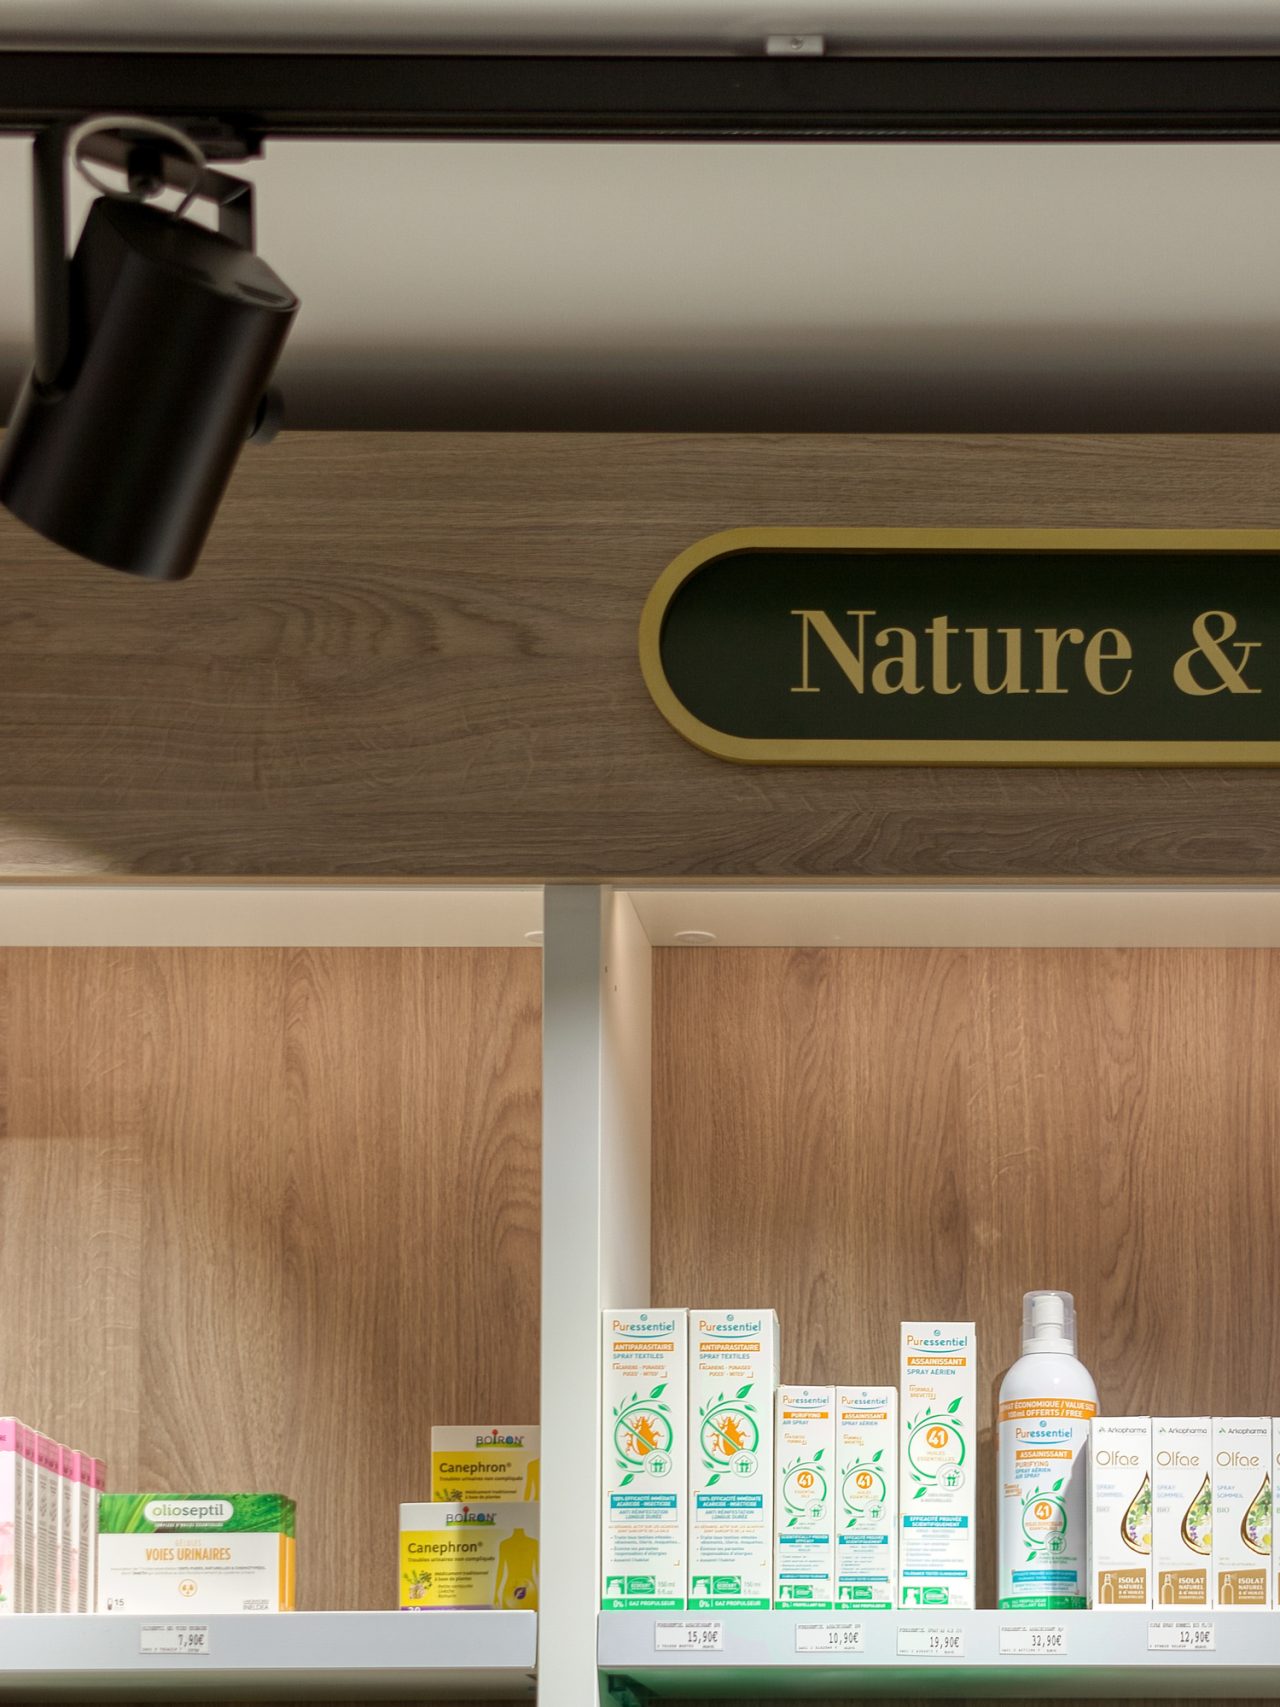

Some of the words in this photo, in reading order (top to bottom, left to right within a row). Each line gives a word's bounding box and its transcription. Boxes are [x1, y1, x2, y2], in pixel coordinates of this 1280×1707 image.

[790, 609, 1133, 697] Nature
[1172, 609, 1262, 697] &
[613, 1320, 675, 1332] Puressentiel
[699, 1320, 761, 1332] Puressentiel
[907, 1335, 967, 1346] Puressentiel
[783, 1395, 829, 1404] Puressentiel
[842, 1396, 888, 1405] Puressentiel
[929, 1430, 946, 1444] 41
[1016, 1428, 1072, 1438] Puressentiel
[1096, 1451, 1139, 1466] Olfae
[1157, 1451, 1199, 1466] Olfae
[1217, 1451, 1259, 1466] Olfae
[799, 1475, 812, 1485] 41
[858, 1475, 871, 1486] 41
[153, 1503, 223, 1519] olioseptil
[1036, 1505, 1050, 1518] 41
[146, 1548, 174, 1561] VOIES
[177, 1548, 231, 1561] URINAIRES
[178, 1634, 205, 1648] 7,90€
[688, 1631, 718, 1643] 15,90€
[829, 1633, 859, 1645] 10,90€
[930, 1636, 960, 1649] 19,90€
[1032, 1635, 1062, 1647] 32,90€
[1180, 1631, 1210, 1644] 12,90€
